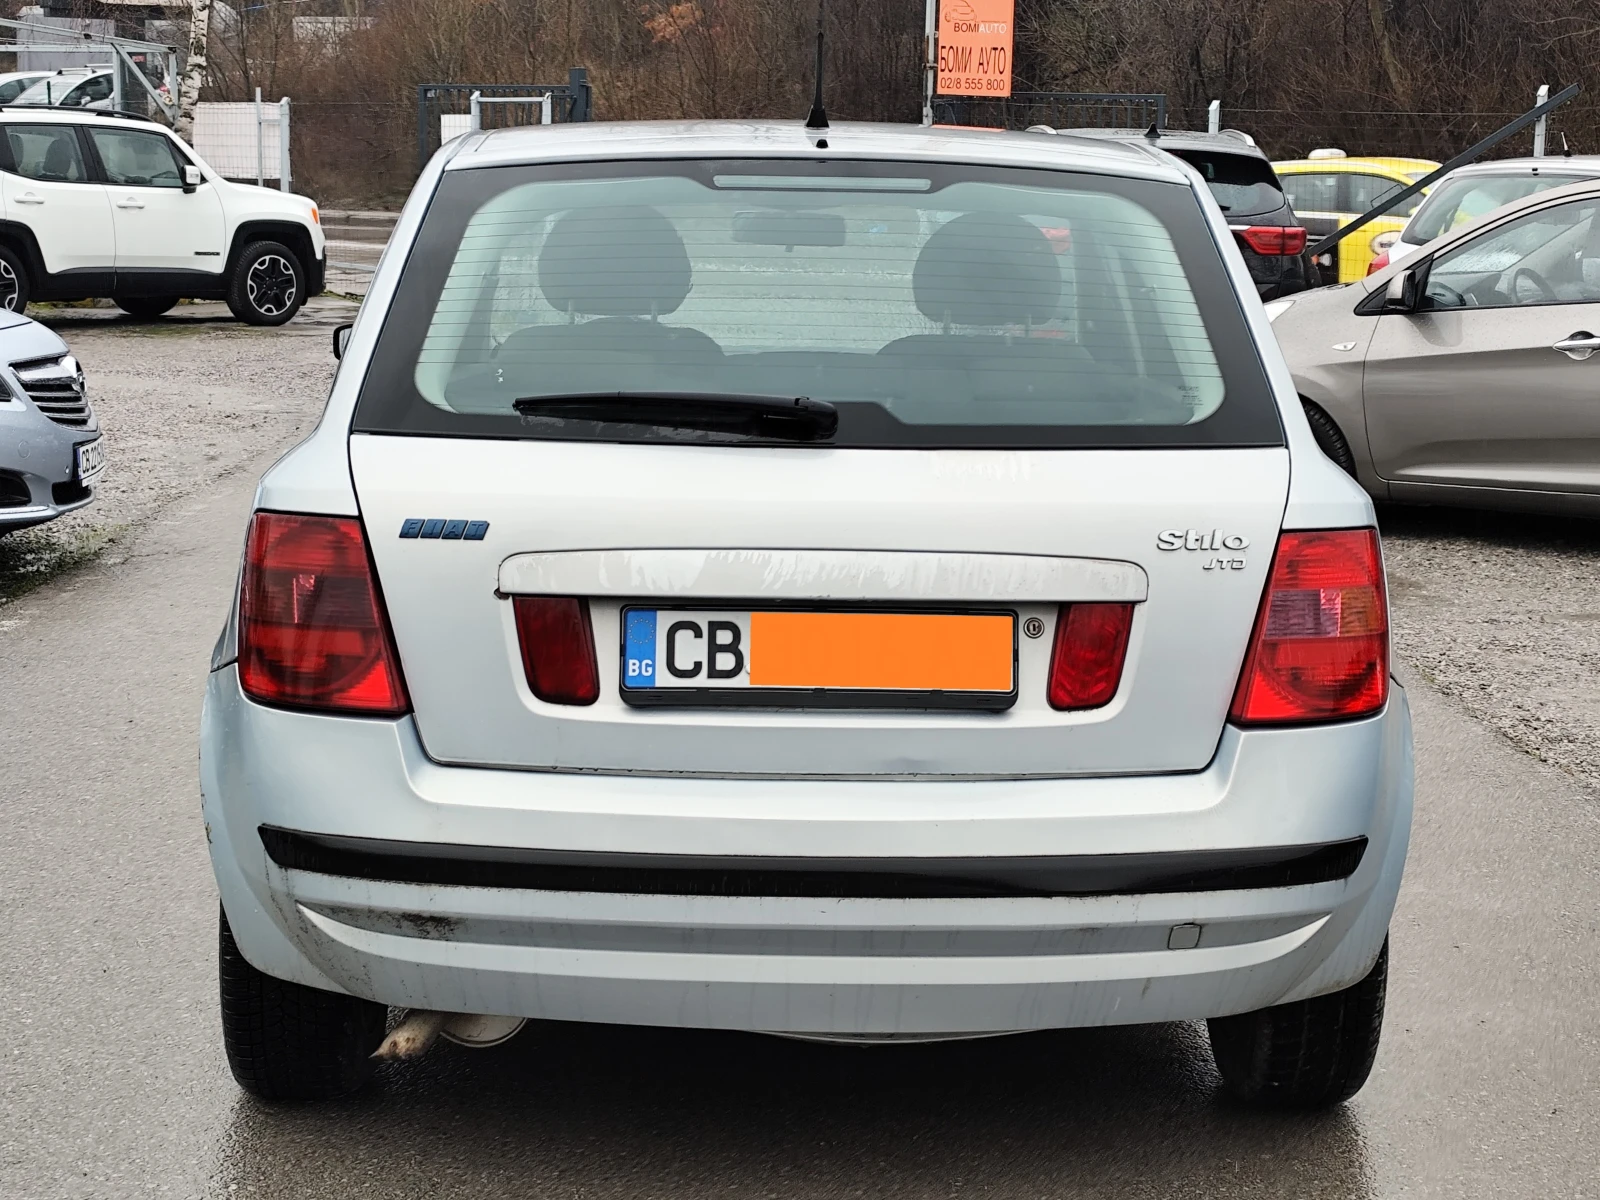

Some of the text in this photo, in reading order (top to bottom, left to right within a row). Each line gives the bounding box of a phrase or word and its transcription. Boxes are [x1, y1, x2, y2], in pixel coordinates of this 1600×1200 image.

[939, 45, 1007, 75] БОМИ АУТО
[940, 77, 1006, 91] 02/8 555 800
[399, 518, 490, 540] FIAT
[1156, 528, 1250, 551] Stilo
[1202, 558, 1247, 570] JTD
[666, 620, 744, 679] CB
[628, 659, 653, 677] BG
